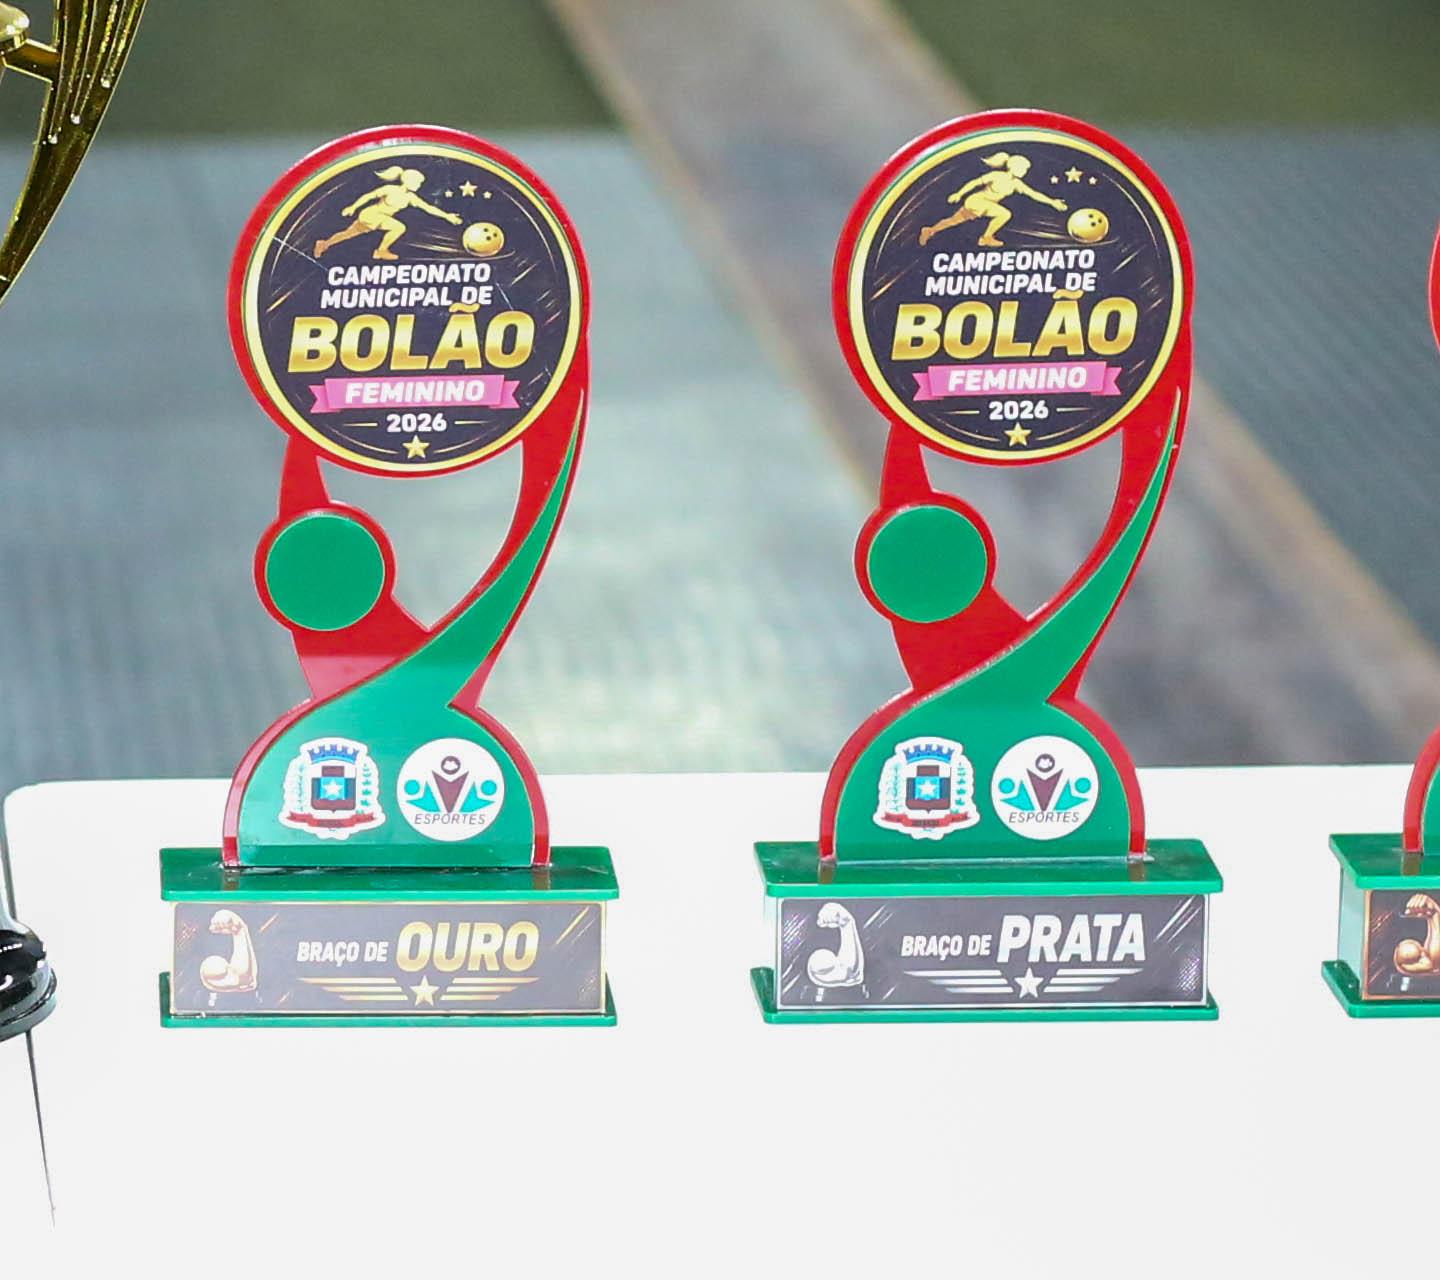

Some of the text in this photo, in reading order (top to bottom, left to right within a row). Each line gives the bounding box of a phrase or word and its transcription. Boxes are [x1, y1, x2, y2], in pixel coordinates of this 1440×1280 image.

[932, 249, 1096, 273] CAMPEONATO
[327, 263, 492, 286] CAMPEONATO
[925, 272, 1098, 296] MUNICIPAL DE
[320, 286, 493, 309] MUNICIPAL DE
[891, 289, 1138, 361] BOLÃO
[287, 303, 536, 373] BOLÃO
[947, 366, 1088, 392] FEMININO
[344, 379, 485, 404] FEMININO
[988, 400, 1049, 420] 2026
[386, 413, 447, 432] 2026
[414, 813, 487, 825] ESPORTES
[1008, 811, 1080, 824] ESPORTES
[296, 920, 540, 972] BRAÇO DE OURO
[901, 913, 1146, 963] BRAÇO DE PRATA
